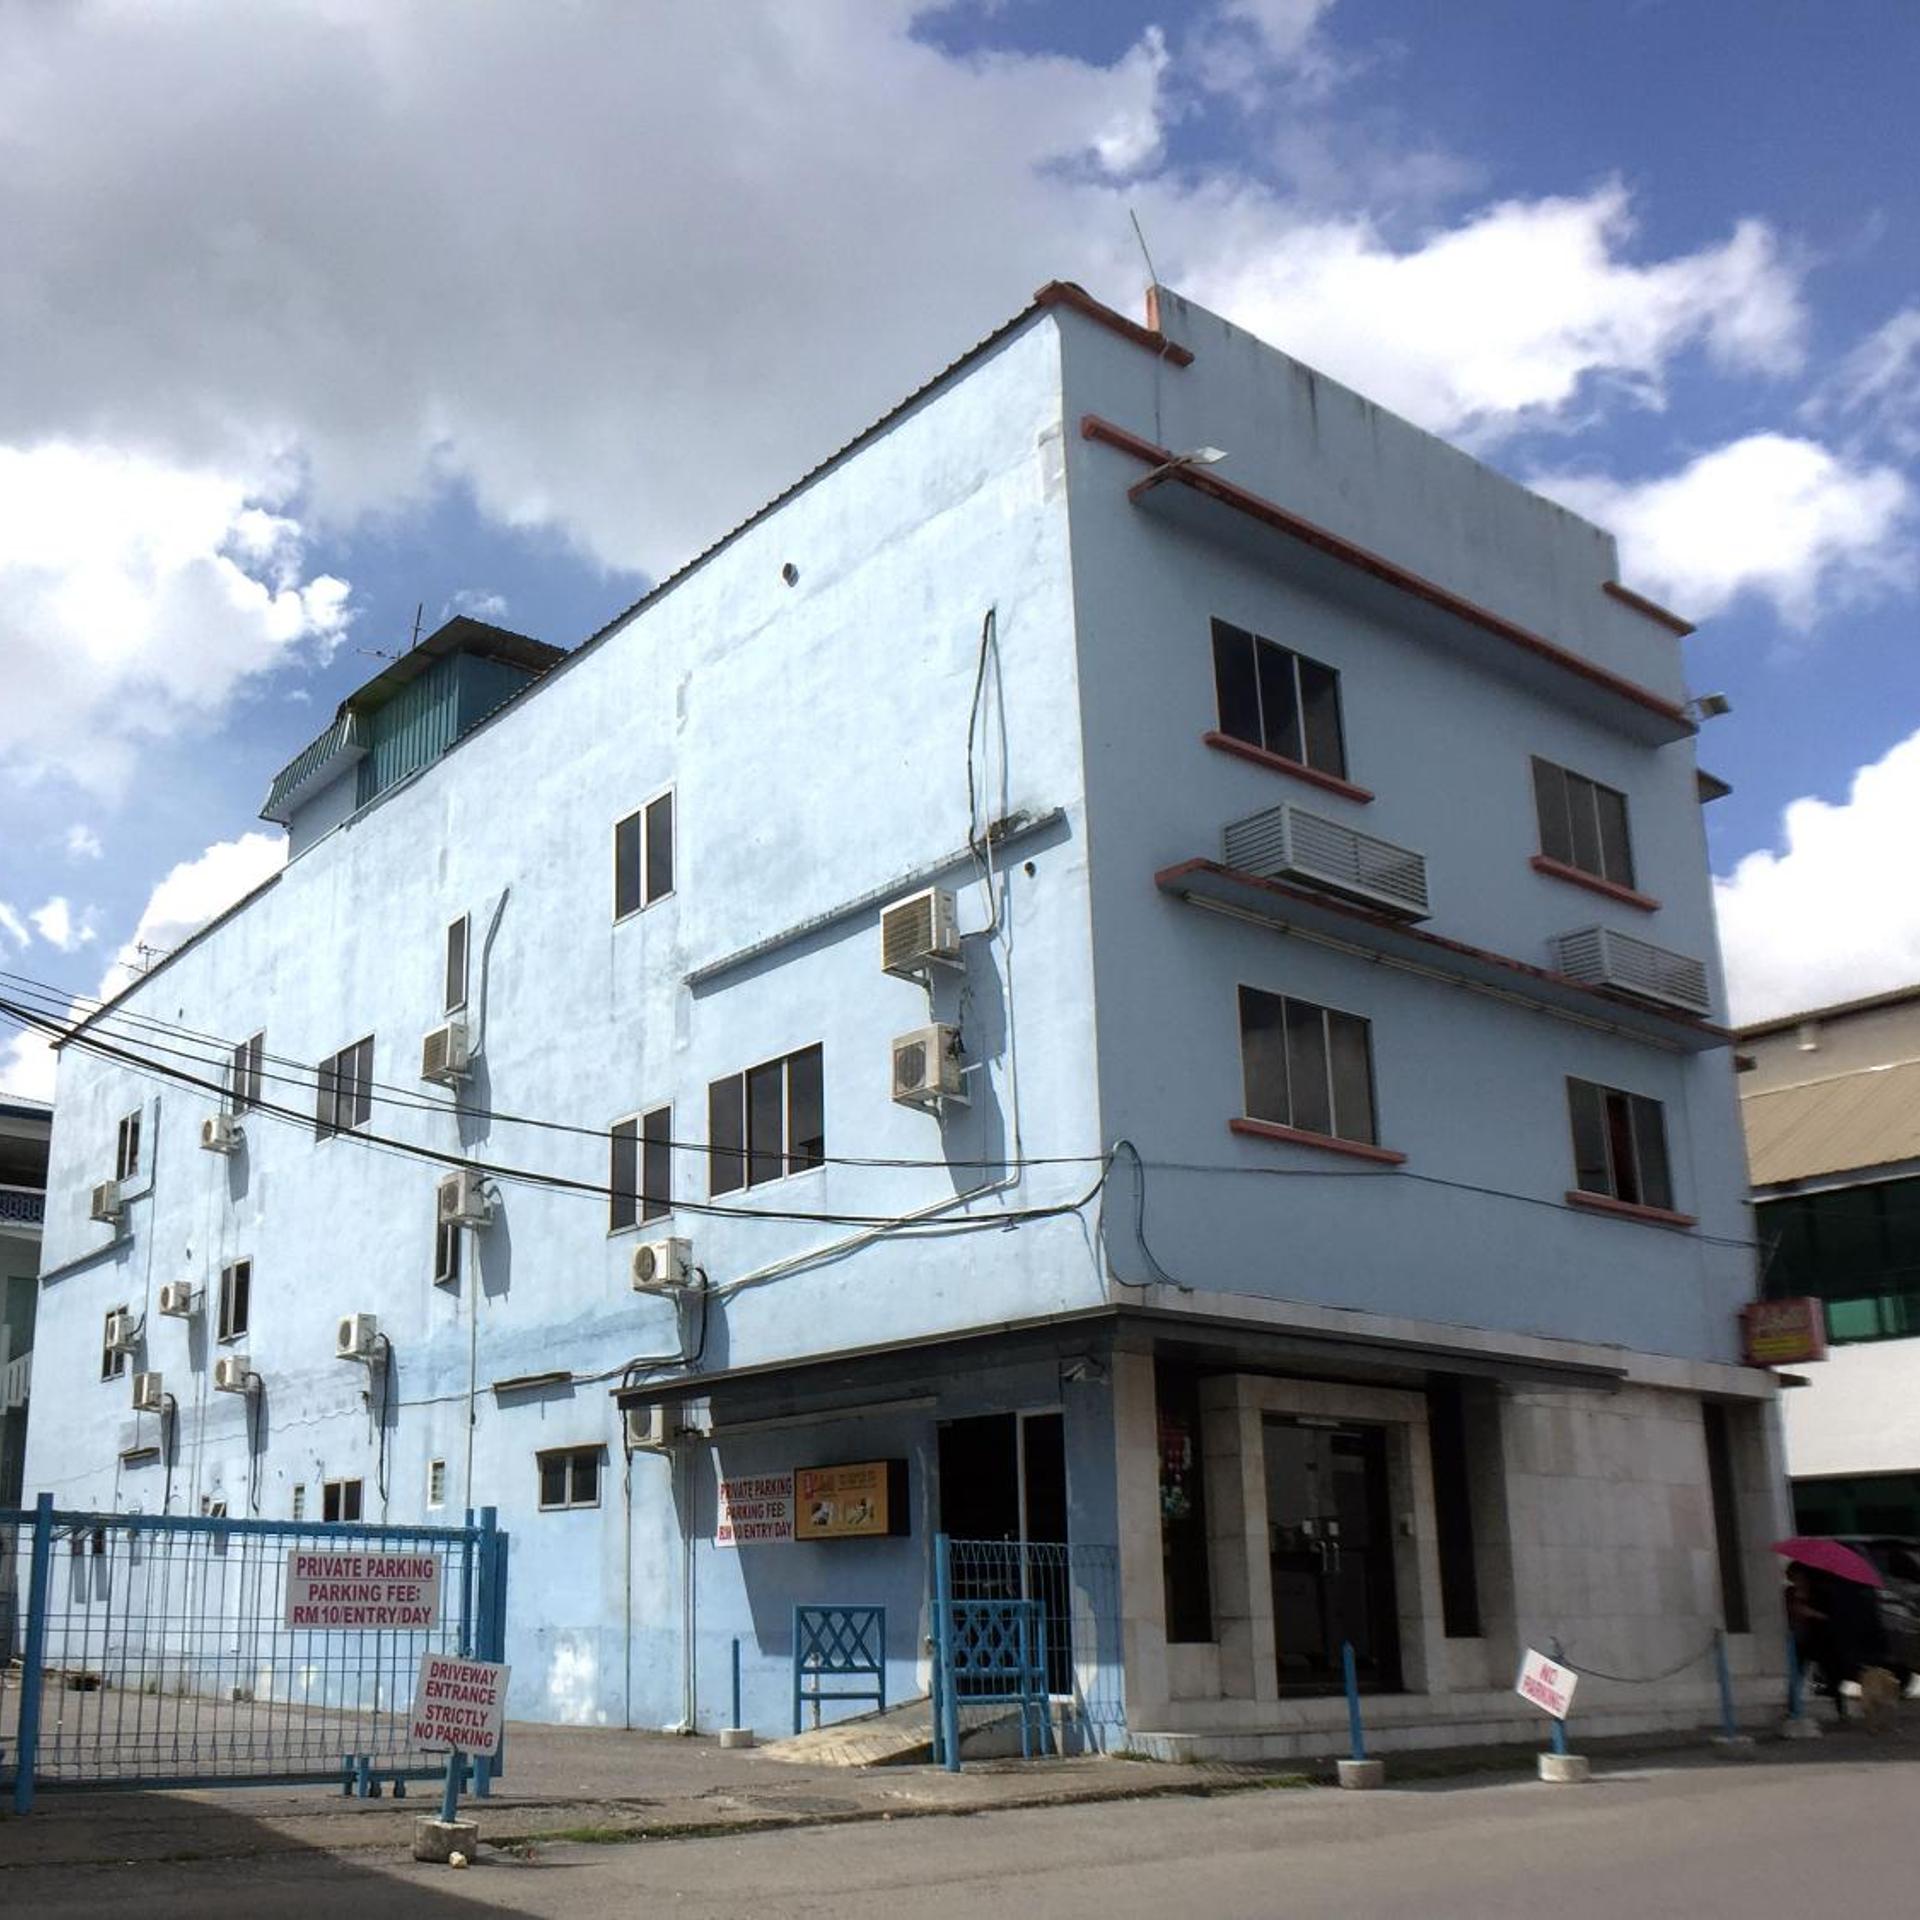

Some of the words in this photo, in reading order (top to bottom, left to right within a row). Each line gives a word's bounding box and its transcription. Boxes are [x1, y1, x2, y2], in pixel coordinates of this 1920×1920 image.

[297, 1556, 361, 1577] PRIVATE
[367, 1557, 433, 1578] PARKING
[309, 1583, 381, 1602] PARKING
[387, 1585, 420, 1602] FEE:
[430, 1661, 498, 1685] DRIVEWAY
[425, 1681, 496, 1705] ENTRANCE
[425, 1704, 488, 1727] STRICTLY
[413, 1722, 433, 1739] NO
[435, 1727, 493, 1748] PARKING
